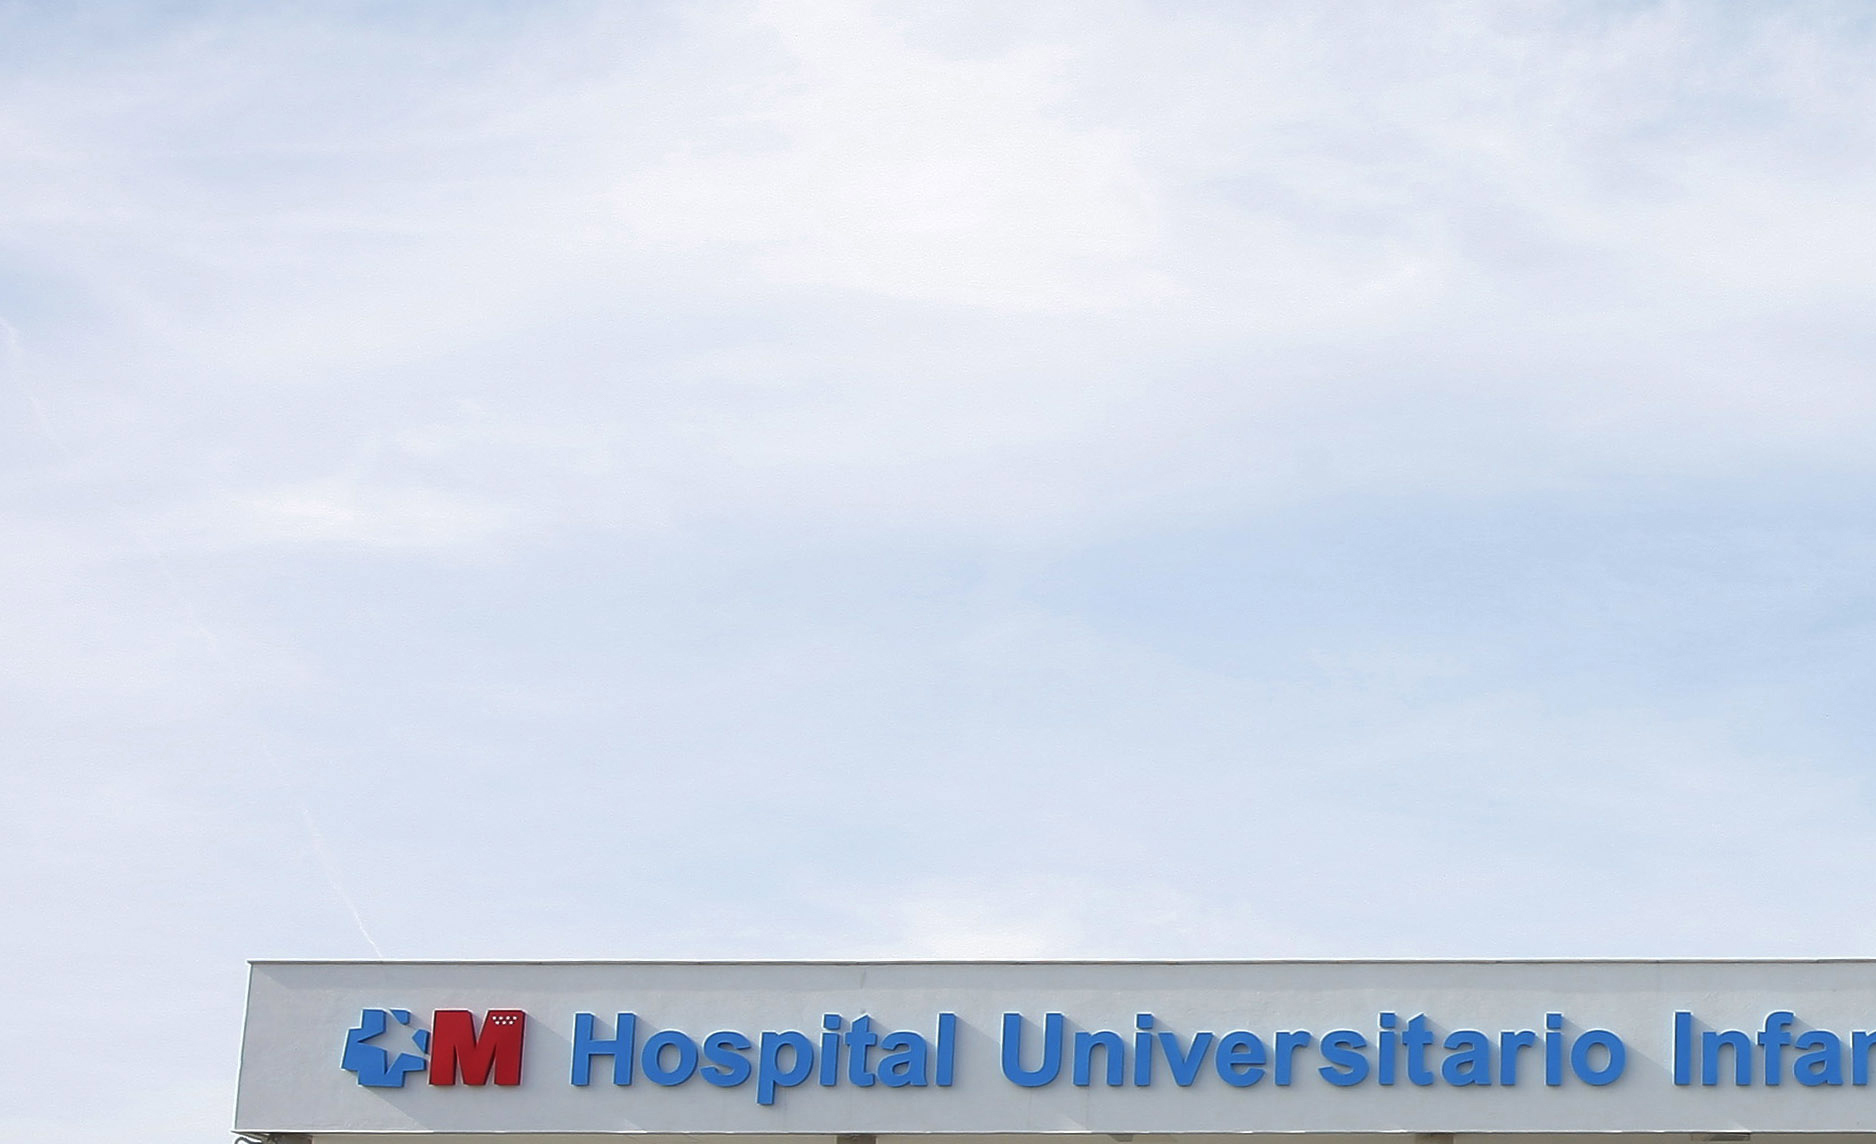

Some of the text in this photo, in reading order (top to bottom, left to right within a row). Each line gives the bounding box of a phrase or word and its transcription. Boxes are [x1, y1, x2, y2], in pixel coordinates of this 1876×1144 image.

[428, 1009, 525, 1086] M
[572, 1012, 956, 1105] Hospital
[1001, 1012, 1627, 1088] Universitario
